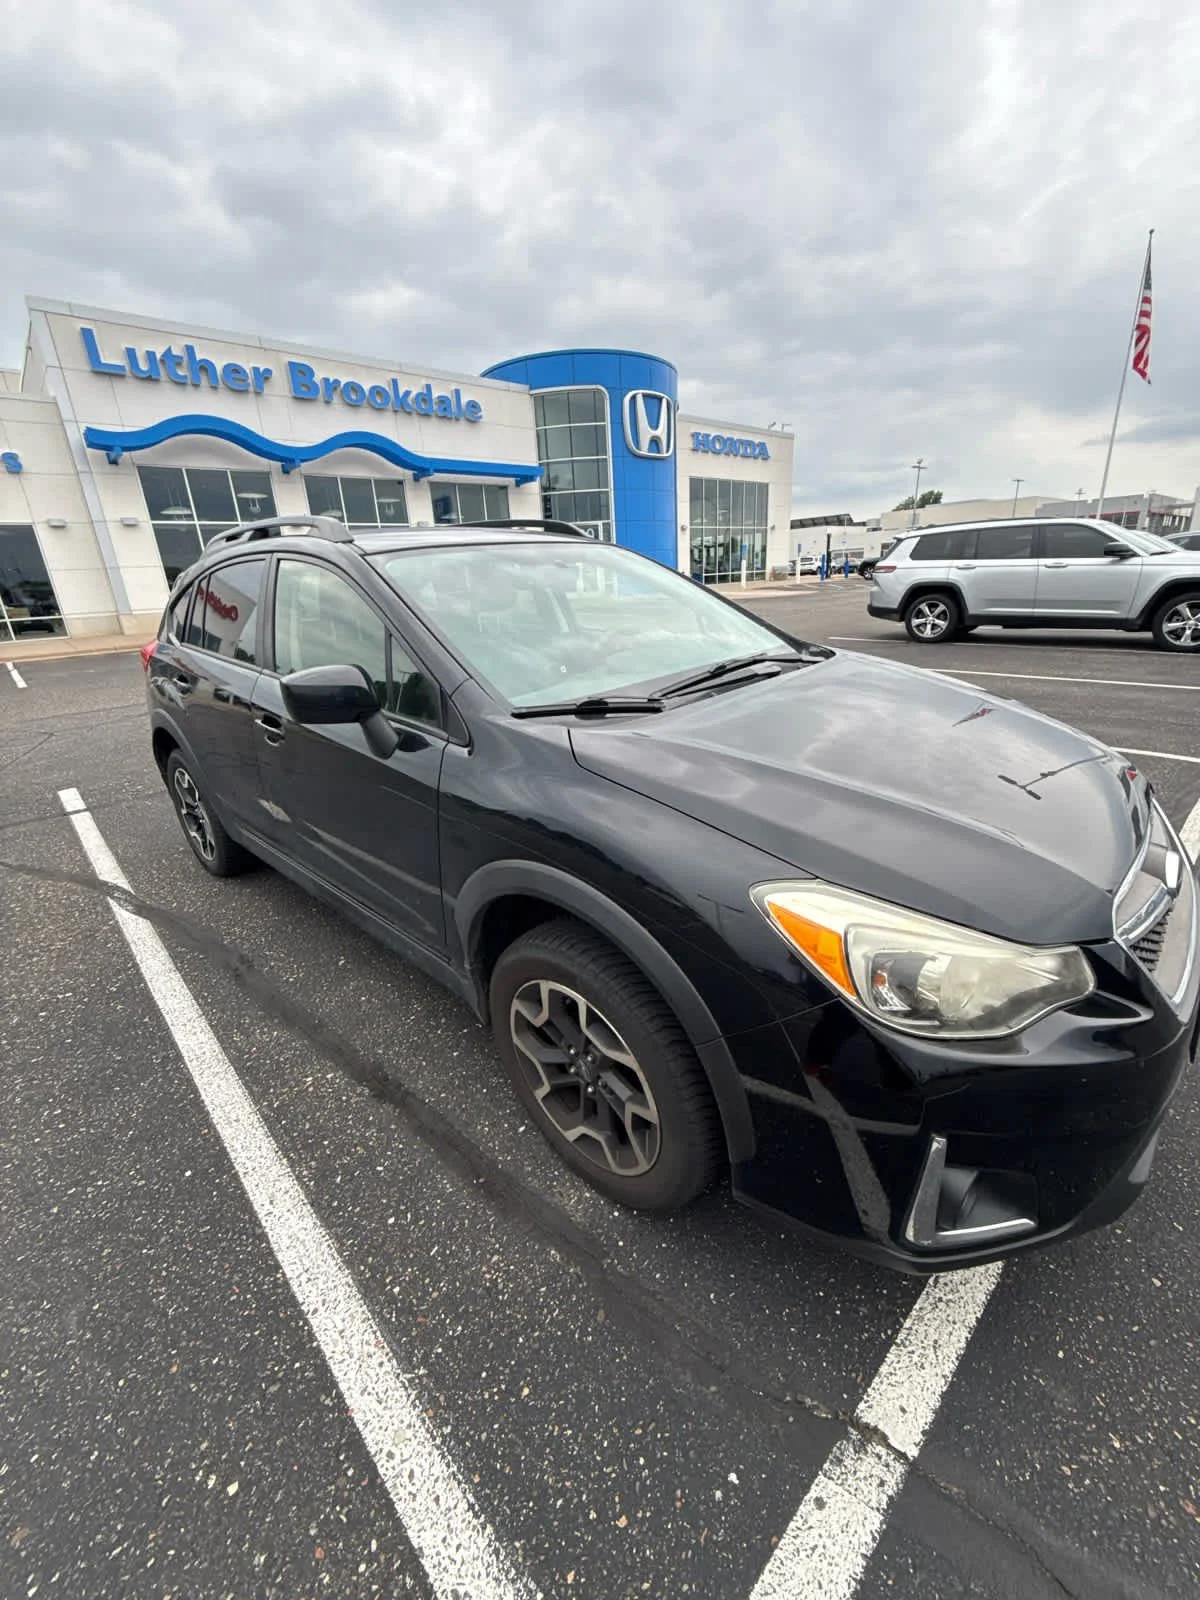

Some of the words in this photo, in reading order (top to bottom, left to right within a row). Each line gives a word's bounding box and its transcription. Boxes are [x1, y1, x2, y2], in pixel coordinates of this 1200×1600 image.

[81, 327, 272, 394] Luther
[287, 361, 483, 422] Brookdale
[691, 432, 770, 460] HONDA
